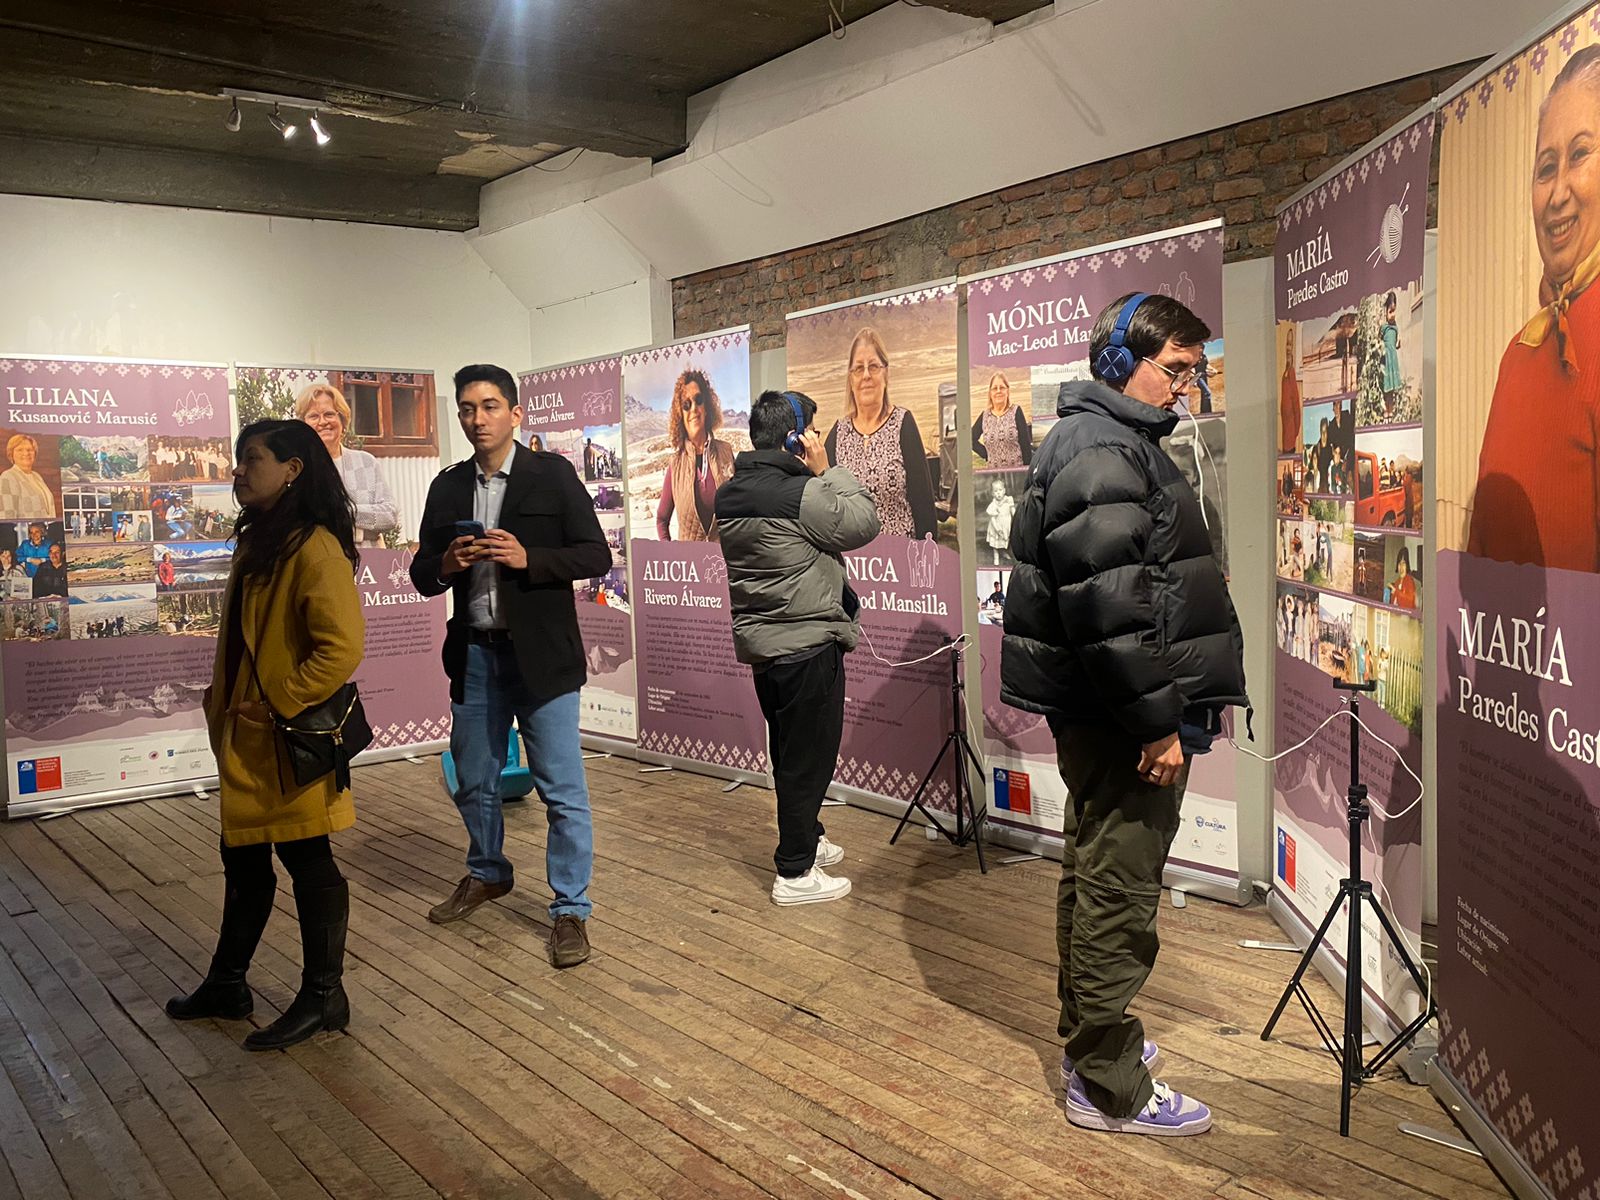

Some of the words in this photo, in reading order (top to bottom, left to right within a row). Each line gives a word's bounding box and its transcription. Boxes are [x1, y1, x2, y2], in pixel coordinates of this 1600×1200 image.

[1287, 226, 1333, 281] MARÍA
[1319, 269, 1349, 294] Castro
[987, 295, 1092, 335] MÓNICA
[987, 329, 1059, 357] Mac-Leod
[7, 387, 118, 407] LILIANA
[527, 392, 564, 411] ALICIA
[8, 409, 91, 424] Kusanović
[96, 411, 158, 425] Marusić
[528, 415, 549, 426] Rivero
[550, 409, 575, 423] Álvarez
[643, 560, 700, 583] ALICIA
[844, 556, 900, 583] NICA
[644, 588, 678, 606] Rivero
[680, 585, 722, 608] Álvarez
[881, 591, 948, 616] Mansilla
[1458, 606, 1573, 687] MARÍA
[1458, 675, 1539, 742] Paredes
